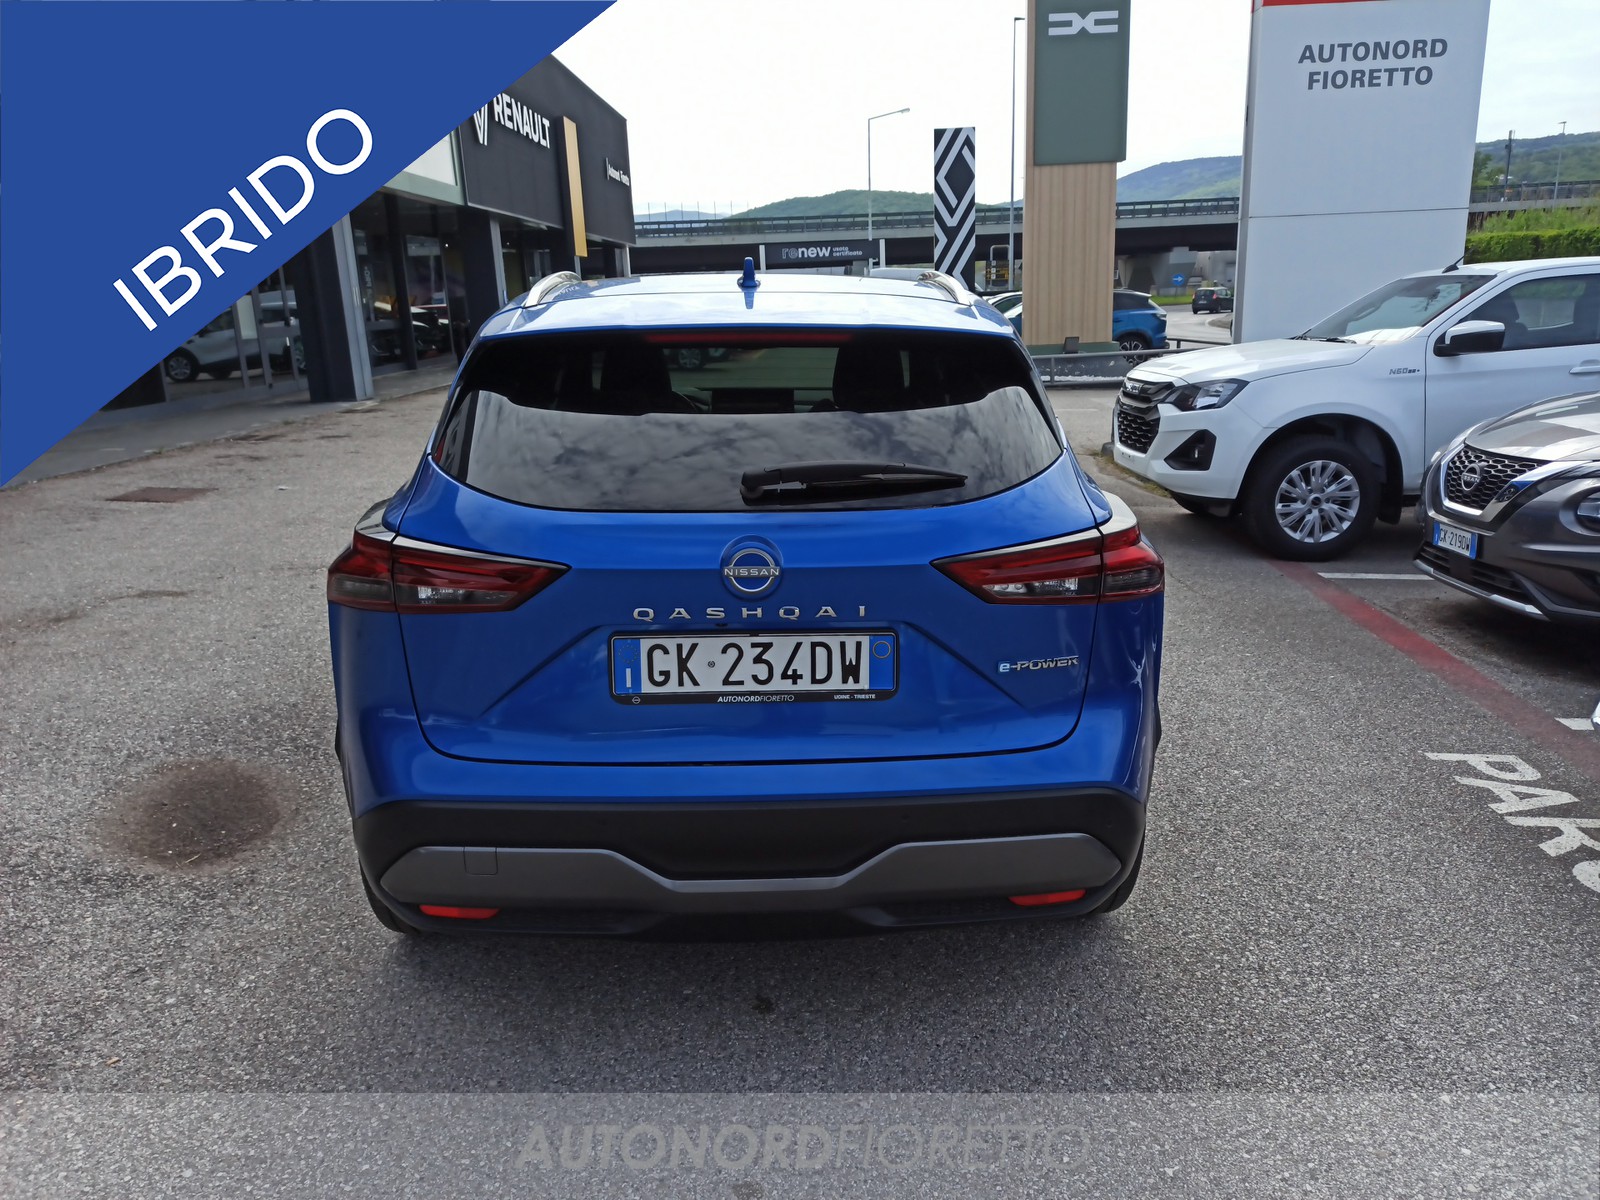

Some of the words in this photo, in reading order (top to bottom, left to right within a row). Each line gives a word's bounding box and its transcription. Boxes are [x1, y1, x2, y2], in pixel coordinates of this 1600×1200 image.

[1298, 38, 1448, 64] AUTONORD
[1307, 65, 1433, 90] FIORETTO
[493, 92, 550, 149] RENAULT
[782, 246, 831, 259] renew
[724, 567, 780, 577] NISSAN
[633, 605, 866, 622] QASHQAI
[647, 642, 701, 688] GK
[720, 640, 863, 686] 234DW
[999, 655, 1079, 673] e-POWER
